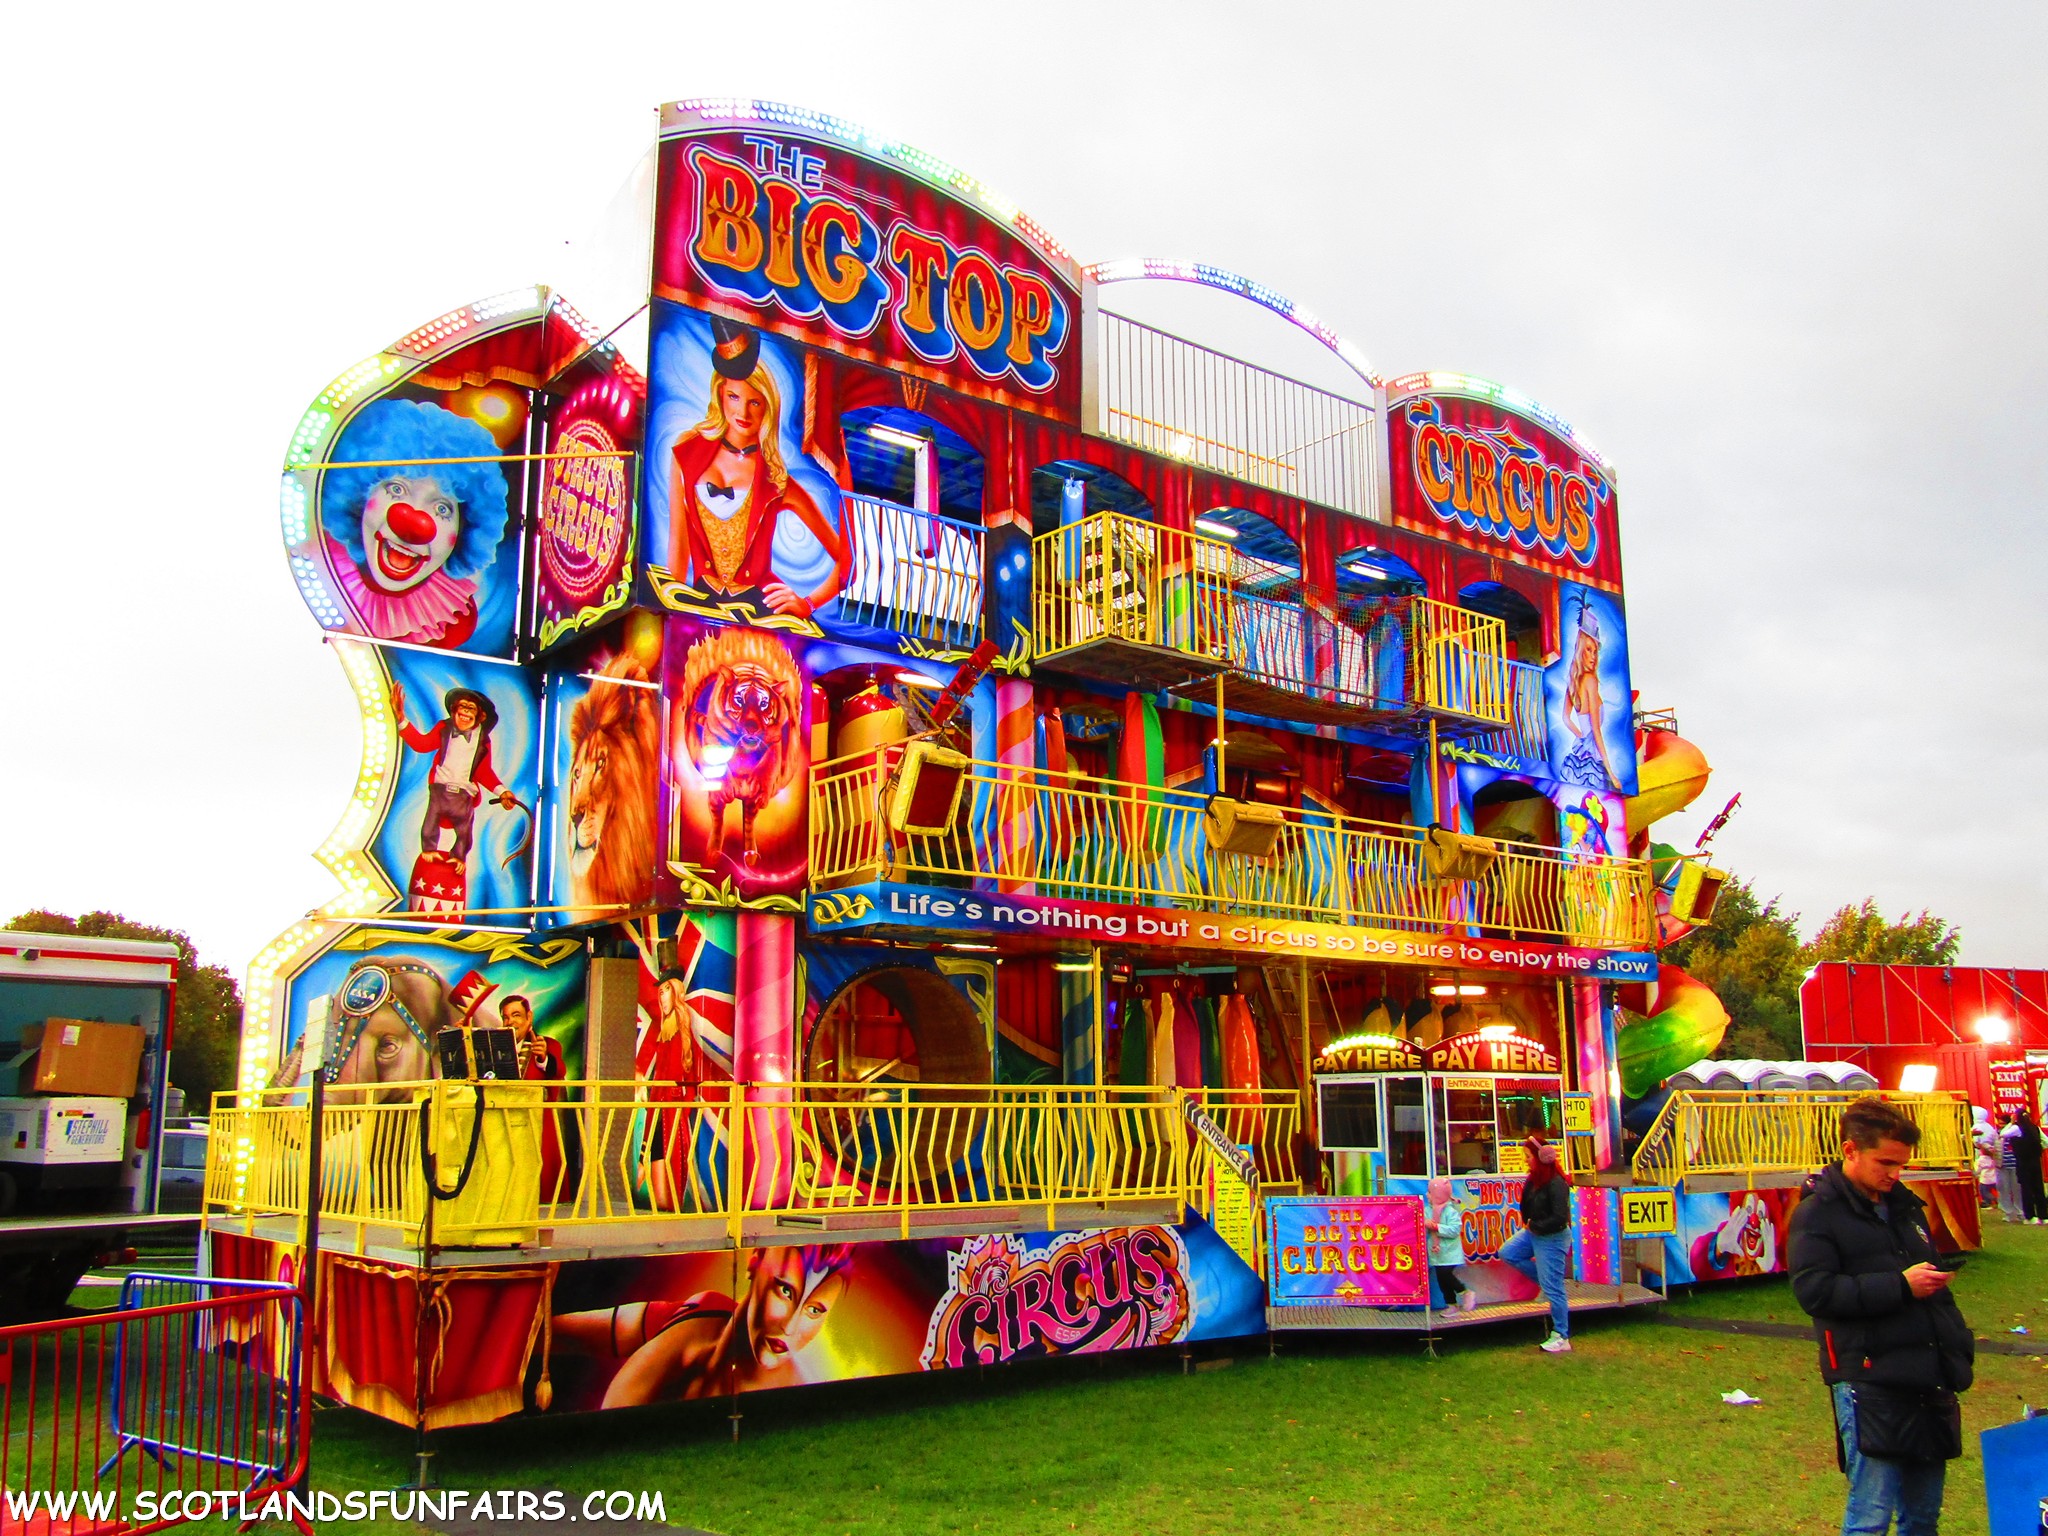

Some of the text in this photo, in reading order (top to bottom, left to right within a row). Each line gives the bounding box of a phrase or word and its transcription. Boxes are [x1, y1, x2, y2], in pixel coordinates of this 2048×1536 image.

[744, 135, 827, 190] THE
[694, 150, 1058, 376] BIG TOP
[552, 432, 624, 509] CIRCUS
[1416, 421, 1592, 556] CIRCUS
[546, 485, 616, 566] CIRCUS
[890, 892, 1649, 973] Life's nothing but a circus so be sure to enjoy the show
[1313, 1048, 1422, 1071] PAY HERE
[1432, 1042, 1557, 1072] PAY HERE
[1448, 1080, 1490, 1089] ENTRANCE
[1996, 1072, 2021, 1082] EXIT
[1998, 1088, 2023, 1098] THIS
[1574, 1101, 1586, 1111] TO
[72, 1120, 109, 1134] STEPHILL
[1565, 1117, 1577, 1127] XIT
[1200, 1118, 1243, 1167] ENTRANCE
[1467, 1181, 1478, 1190] THE
[1480, 1181, 1525, 1205] BIG TO
[1328, 1209, 1362, 1222] THE
[1628, 1201, 1668, 1223] EXIT
[1303, 1224, 1389, 1243] BIG TOP
[1460, 1208, 1522, 1257] CIRC
[1281, 1244, 1414, 1275] CIRCUS
[946, 1230, 1165, 1368] CIRCUS
